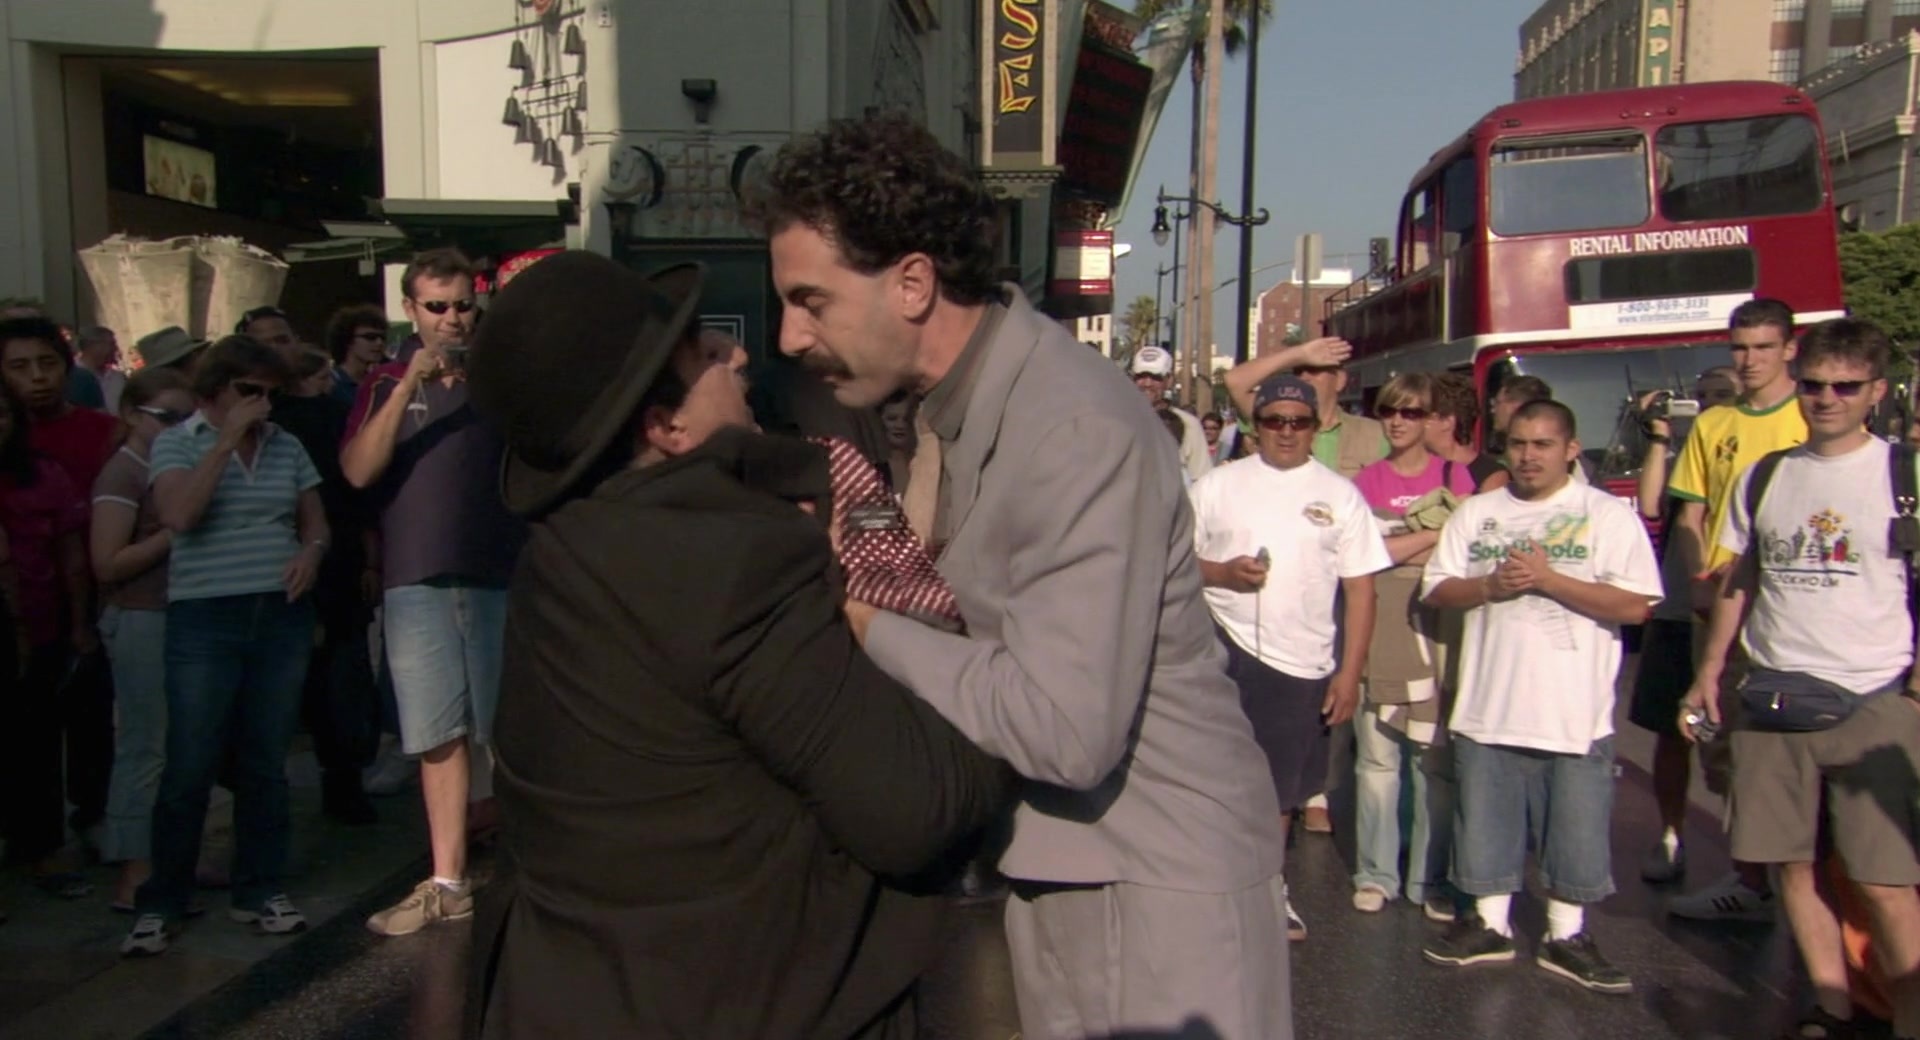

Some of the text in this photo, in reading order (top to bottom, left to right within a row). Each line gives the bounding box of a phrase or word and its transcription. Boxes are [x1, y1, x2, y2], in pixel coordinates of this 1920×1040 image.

[1570, 226, 1749, 256] RENTAL INFORMATION
[1277, 386, 1304, 399] USA
